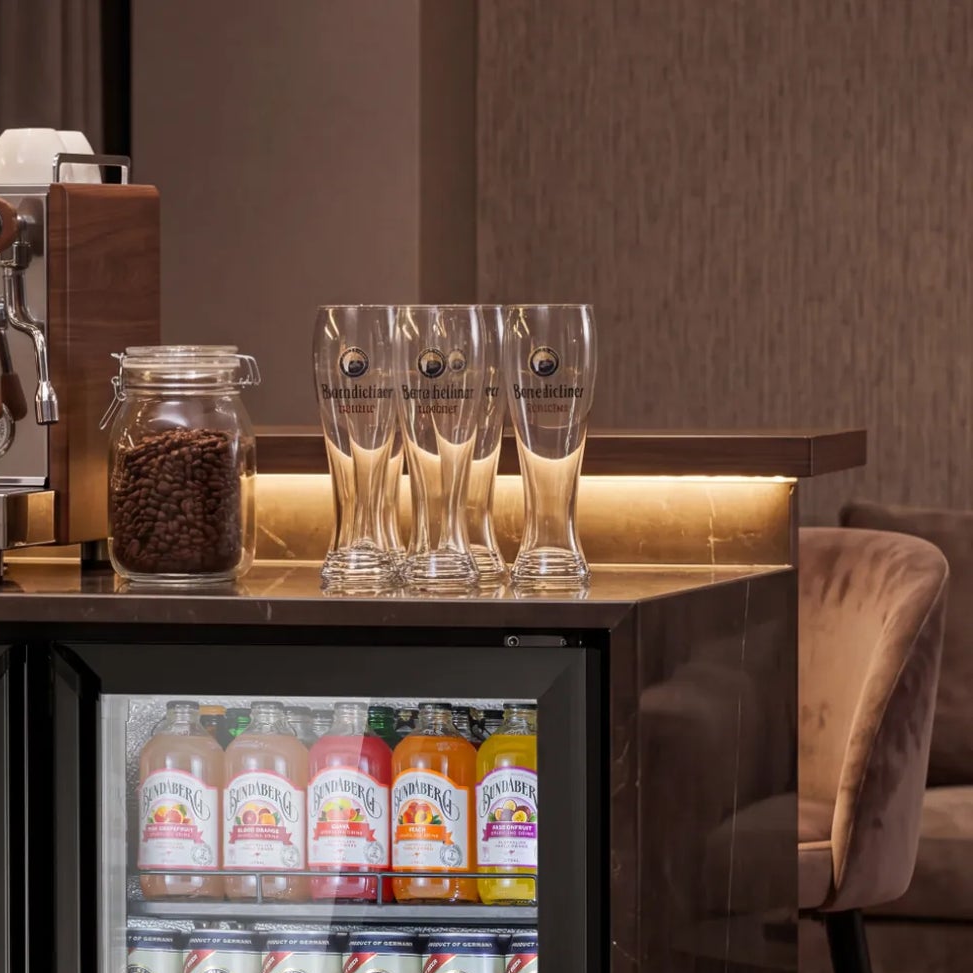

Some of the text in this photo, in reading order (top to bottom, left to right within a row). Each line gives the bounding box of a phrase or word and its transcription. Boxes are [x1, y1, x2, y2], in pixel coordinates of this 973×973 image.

[141, 779, 210, 821] BUNDABERG
[227, 780, 299, 822] BUNDABERG
[311, 777, 382, 818] BUNDABERG
[393, 777, 460, 821] BUNDABERG
